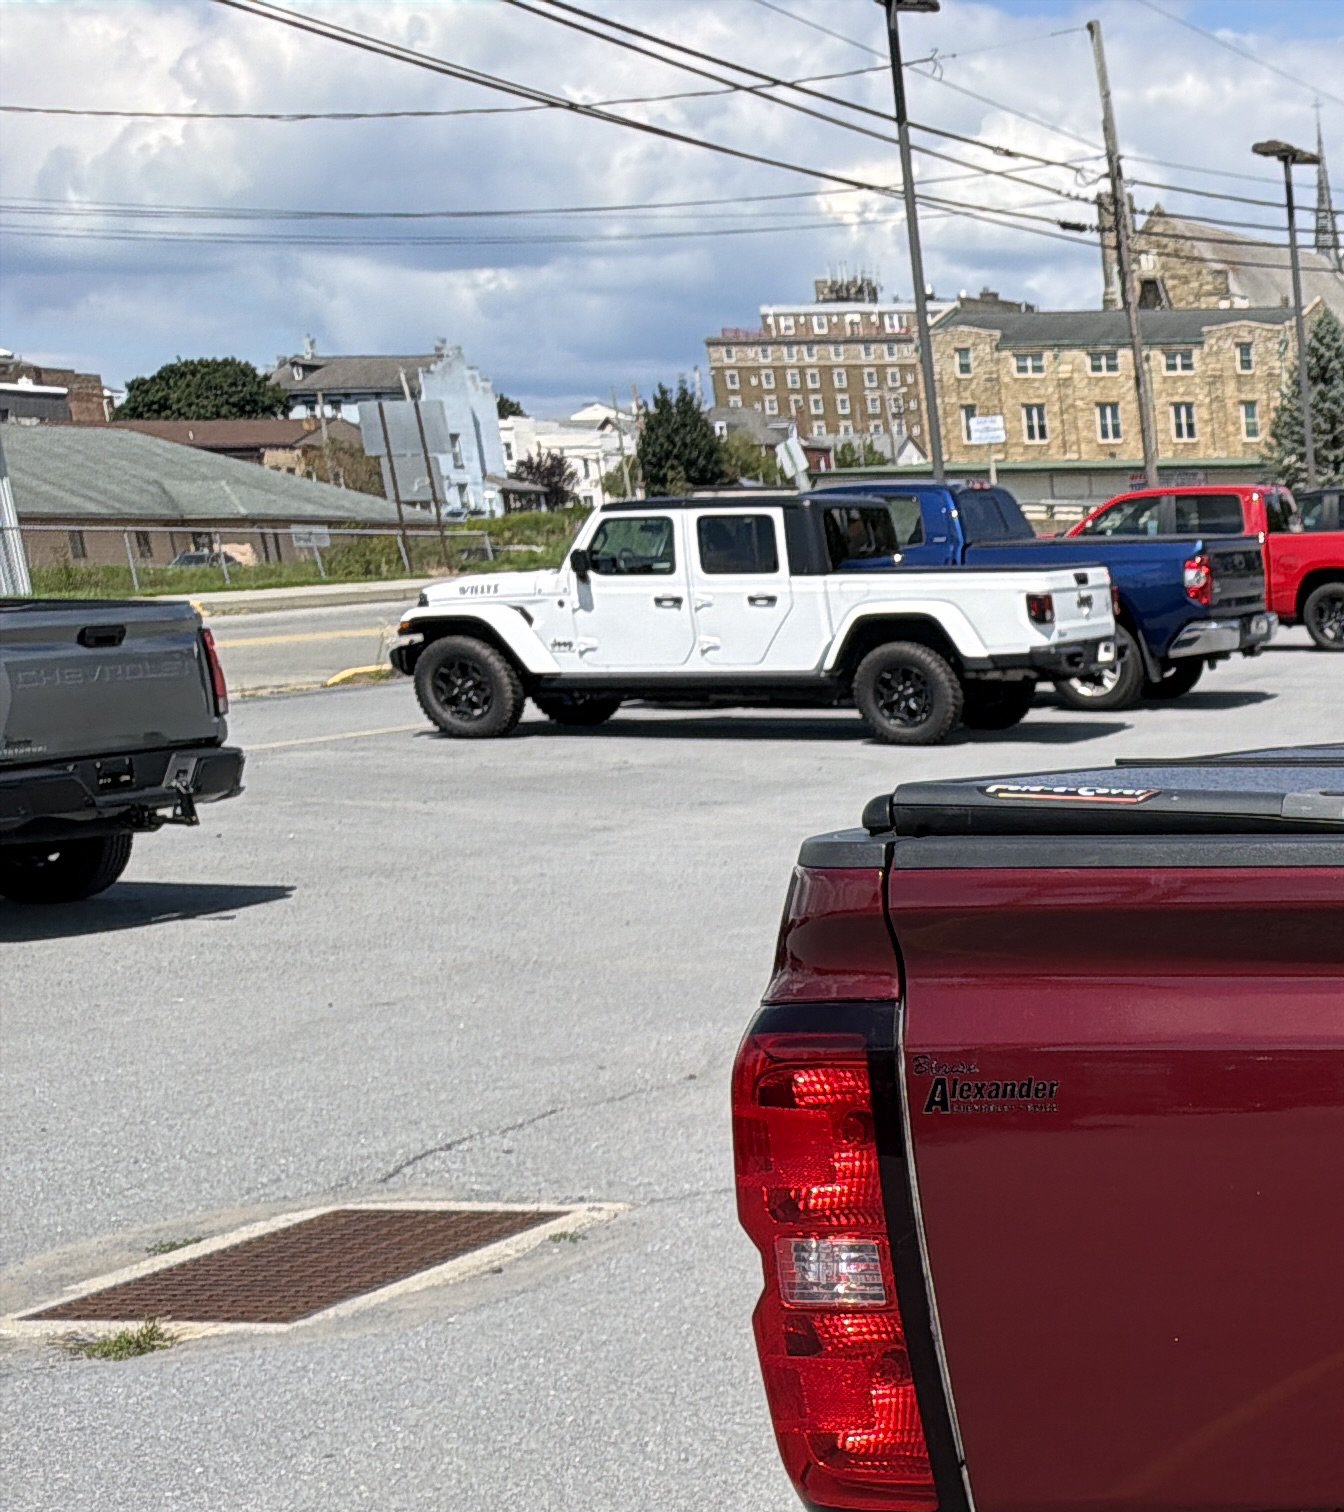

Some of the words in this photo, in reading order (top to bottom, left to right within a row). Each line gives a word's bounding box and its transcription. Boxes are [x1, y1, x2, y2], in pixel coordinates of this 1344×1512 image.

[458, 584, 499, 595] WILLYS
[17, 660, 191, 688] CHEVROLET
[923, 1075, 1059, 1114] Alexander
